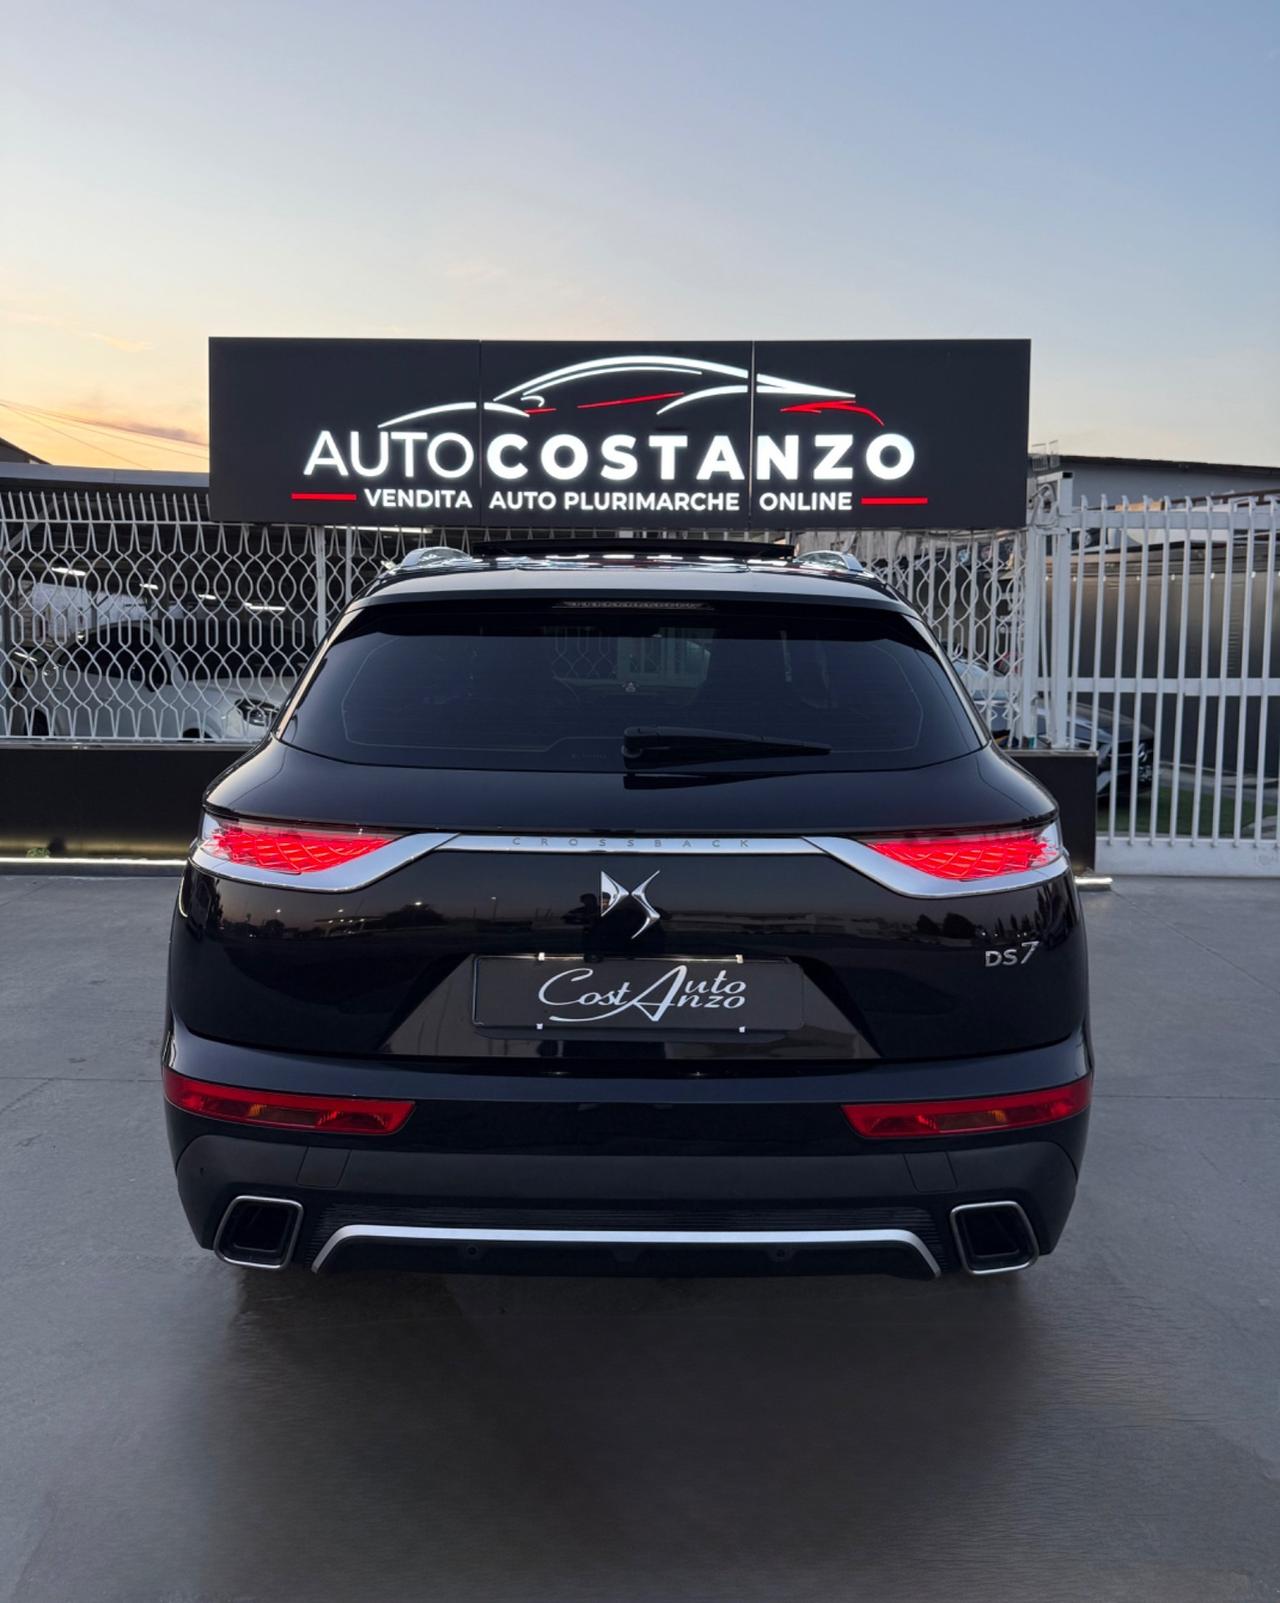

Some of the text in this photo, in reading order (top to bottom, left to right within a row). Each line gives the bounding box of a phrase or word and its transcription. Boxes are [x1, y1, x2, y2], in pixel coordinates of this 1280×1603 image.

[363, 488, 853, 512] VENDITA AUTO PLURIMARCHE ONLINE
[512, 836, 750, 848] CROSSBACK
